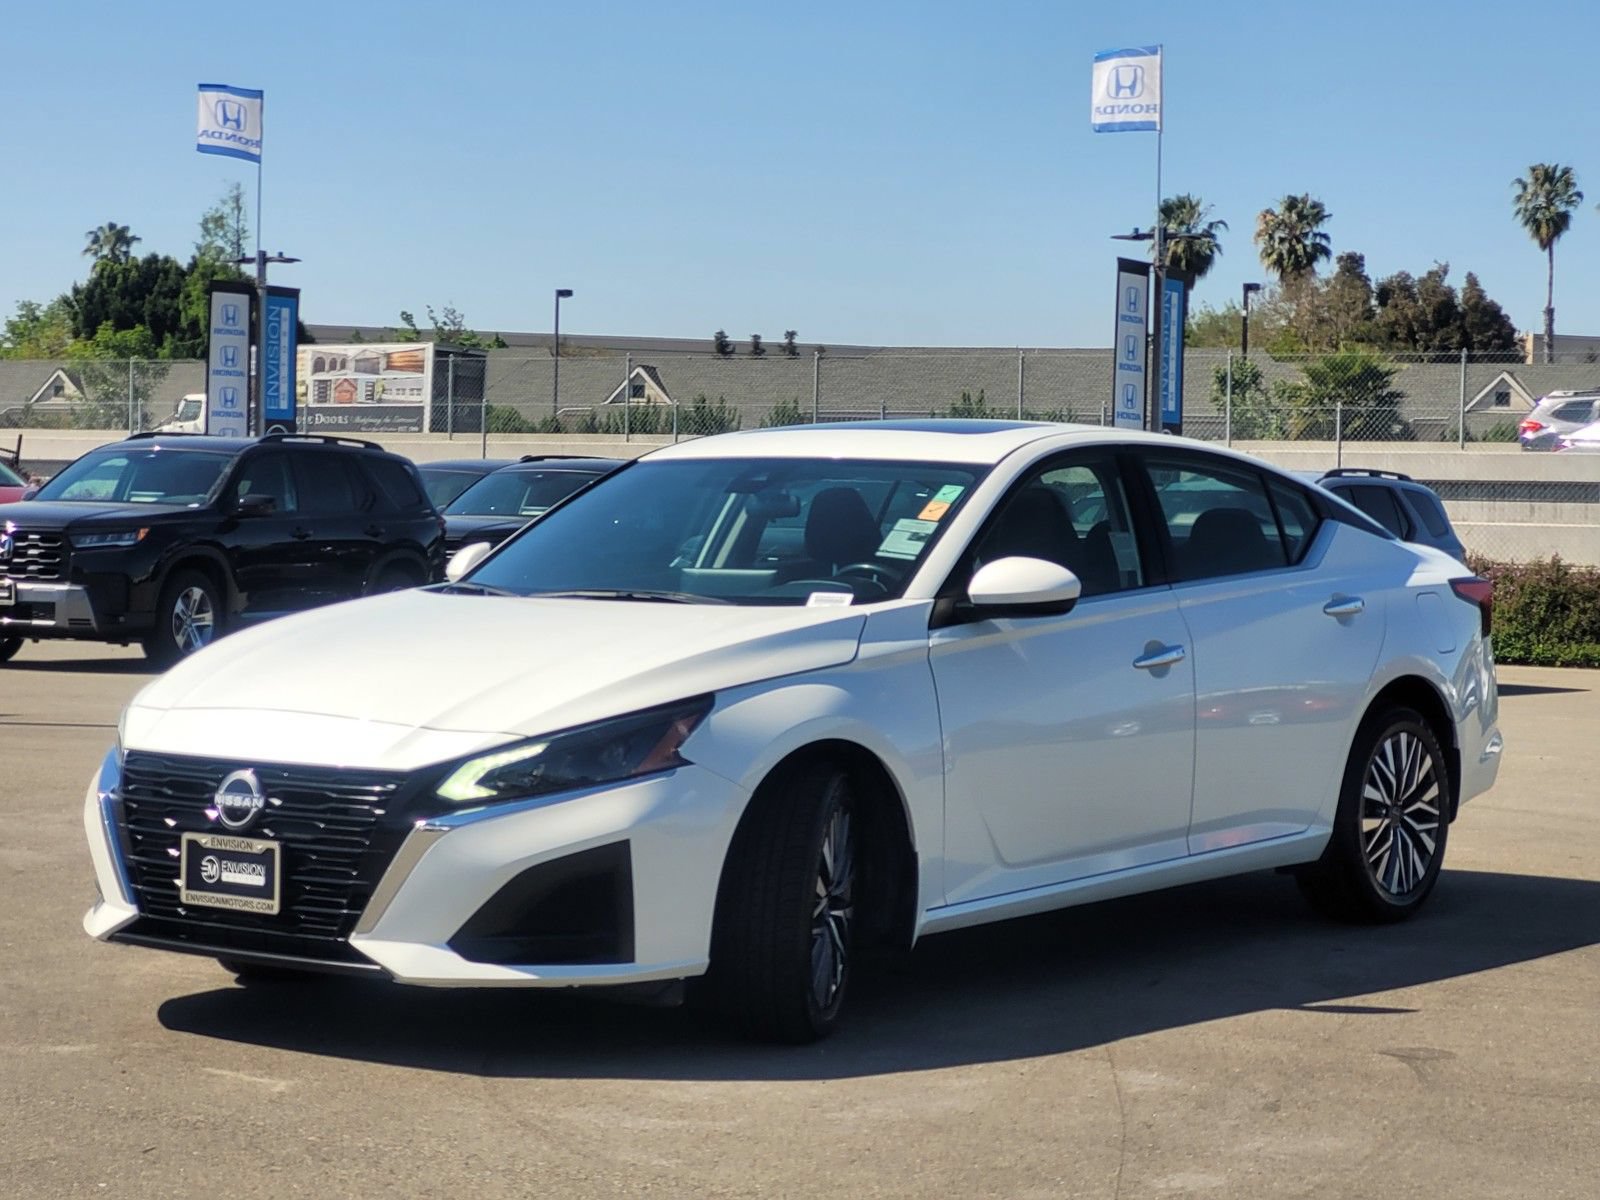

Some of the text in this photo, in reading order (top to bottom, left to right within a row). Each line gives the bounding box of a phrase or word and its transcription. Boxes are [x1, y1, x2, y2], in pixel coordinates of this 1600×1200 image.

[1120, 313, 1144, 325] HONDA
[213, 328, 246, 337] HONDA
[266, 305, 281, 410] ENVISION
[212, 369, 245, 377] HONDA
[1118, 361, 1142, 373] HONDA
[211, 410, 244, 419] HONDA
[1116, 410, 1141, 421] HONDA
[214, 793, 265, 809] NISSAN
[211, 837, 253, 850] ENVISION
[221, 860, 265, 876] ENVISION
[185, 894, 274, 911] ENVISIONMOTORS.COM
